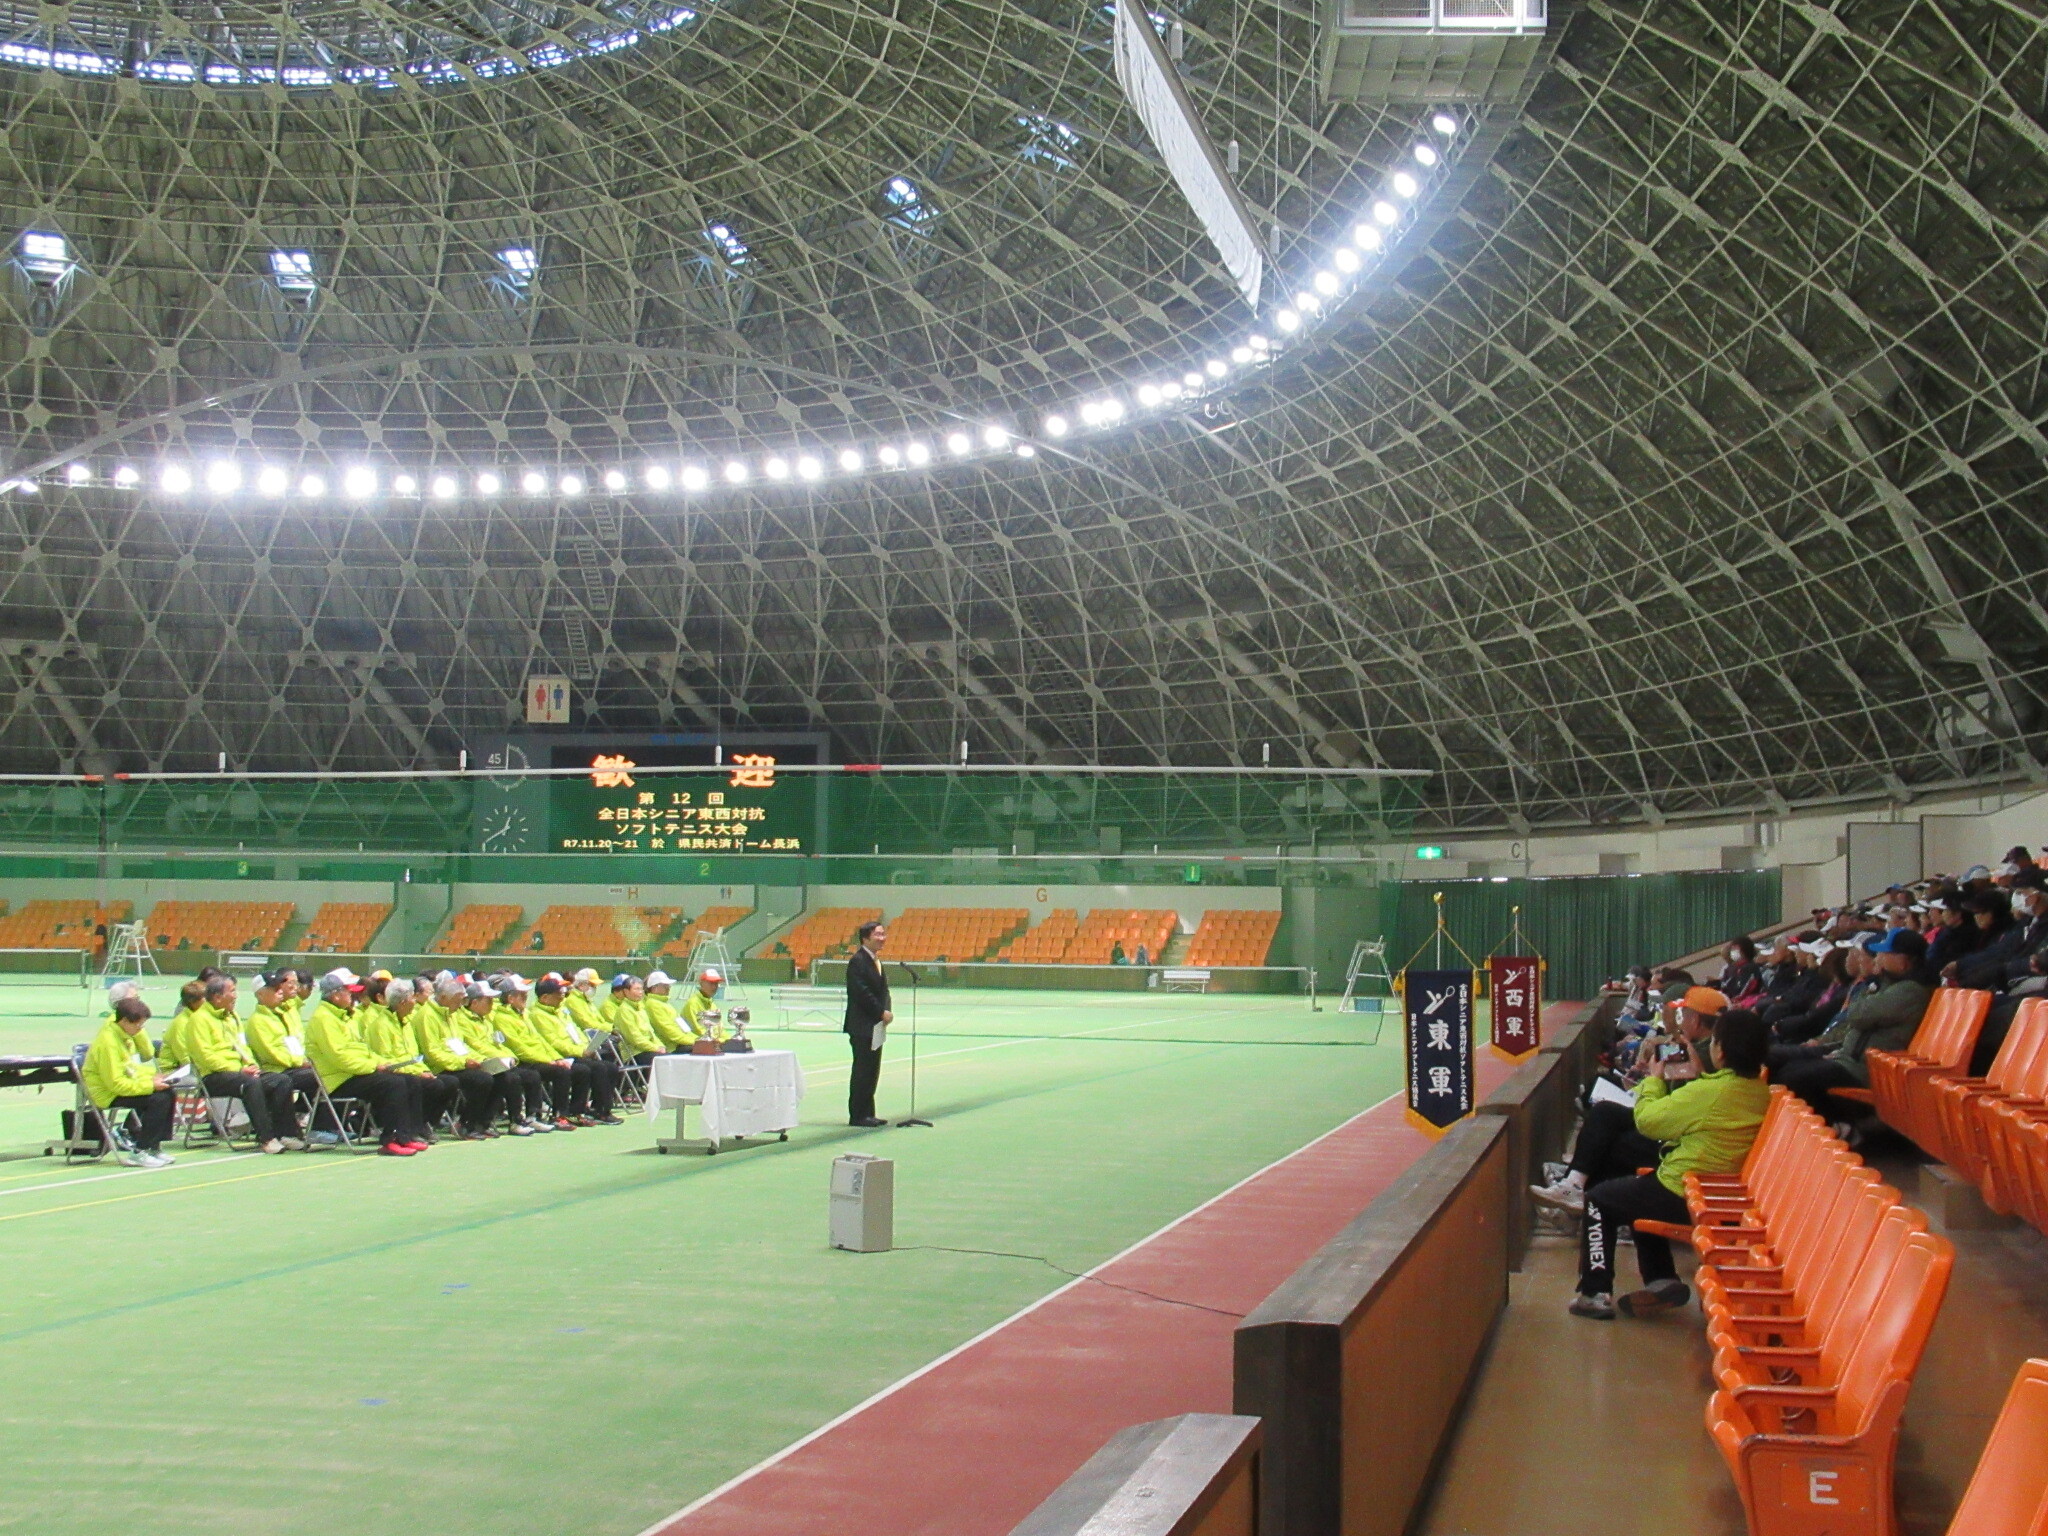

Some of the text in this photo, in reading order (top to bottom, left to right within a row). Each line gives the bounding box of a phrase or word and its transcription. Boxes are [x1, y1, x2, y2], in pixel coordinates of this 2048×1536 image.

[488, 754, 501, 764] 45
[730, 754, 775, 787] 迎
[638, 792, 724, 805] 第 12 回
[598, 807, 765, 820] 全日本シニア東西対抗
[616, 823, 748, 835] ソフトテニス大会
[1511, 842, 1521, 858] C
[701, 862, 710, 876] 2
[627, 886, 639, 900] H
[1036, 887, 1048, 902] G
[1505, 989, 1524, 1036] 西軍
[1427, 1019, 1453, 1097] 東軍
[1588, 1222, 1606, 1271] YONEX
[1809, 1471, 1840, 1505] E
